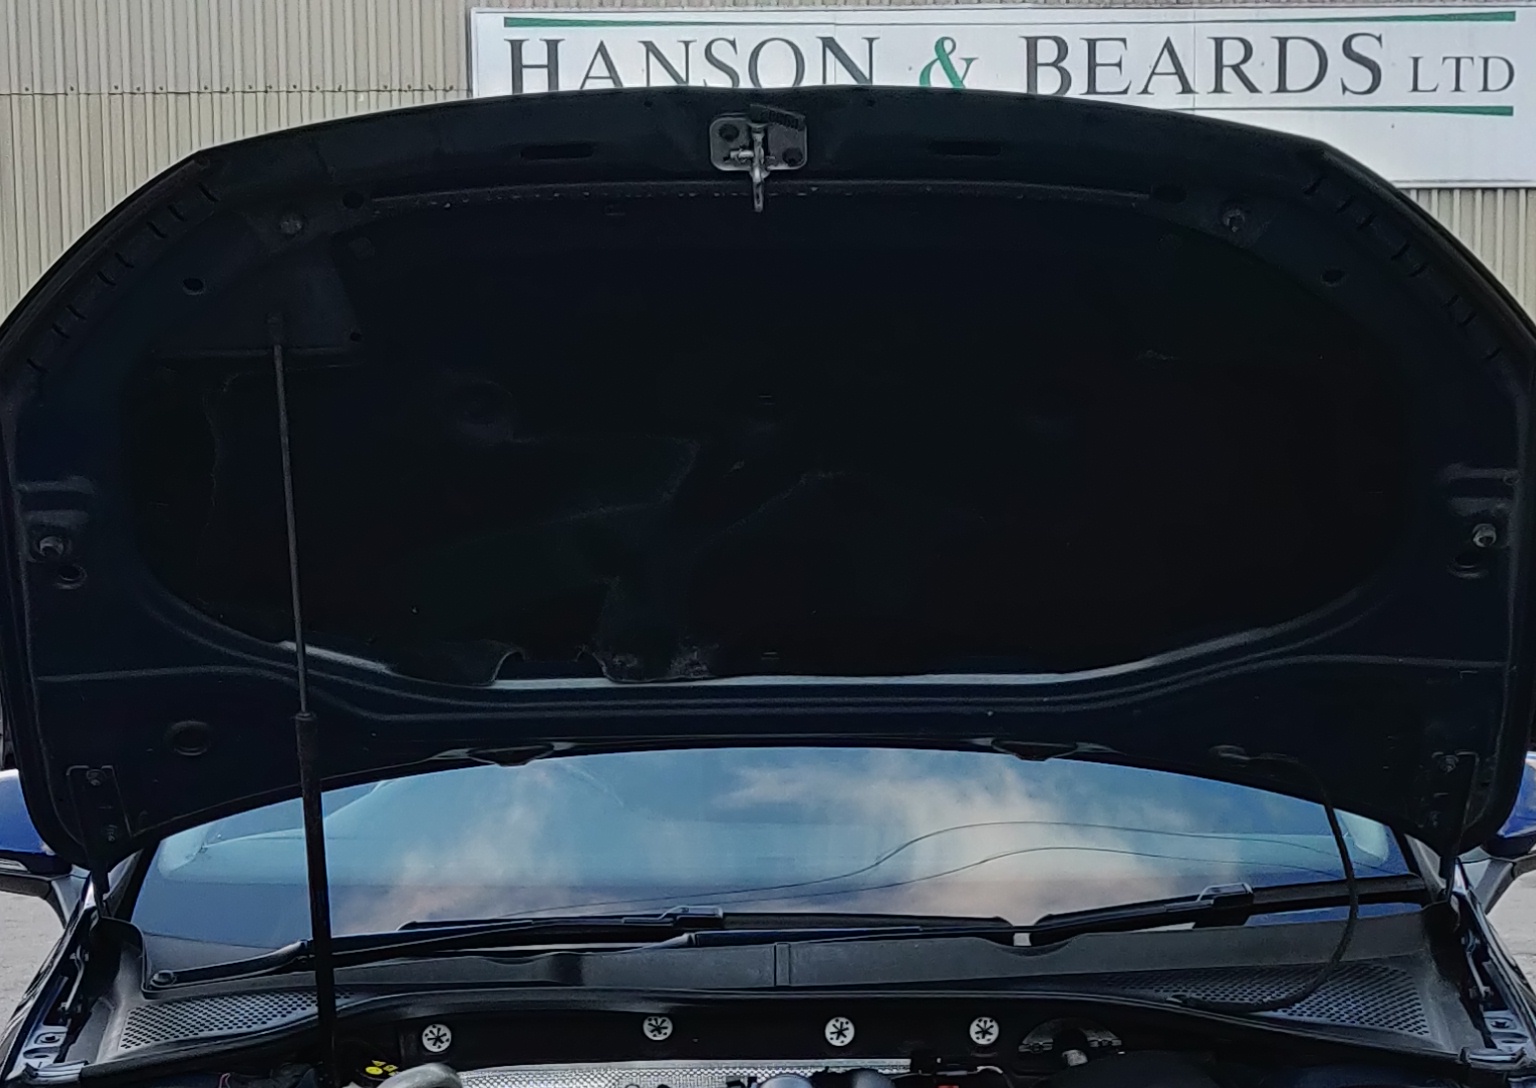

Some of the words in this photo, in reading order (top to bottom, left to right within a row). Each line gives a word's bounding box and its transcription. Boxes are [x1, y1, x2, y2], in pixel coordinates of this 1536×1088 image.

[504, 36, 881, 95] HANSON
[919, 36, 979, 89] &
[1019, 32, 1383, 97] BEARDS
[1407, 55, 1515, 94] LTD
